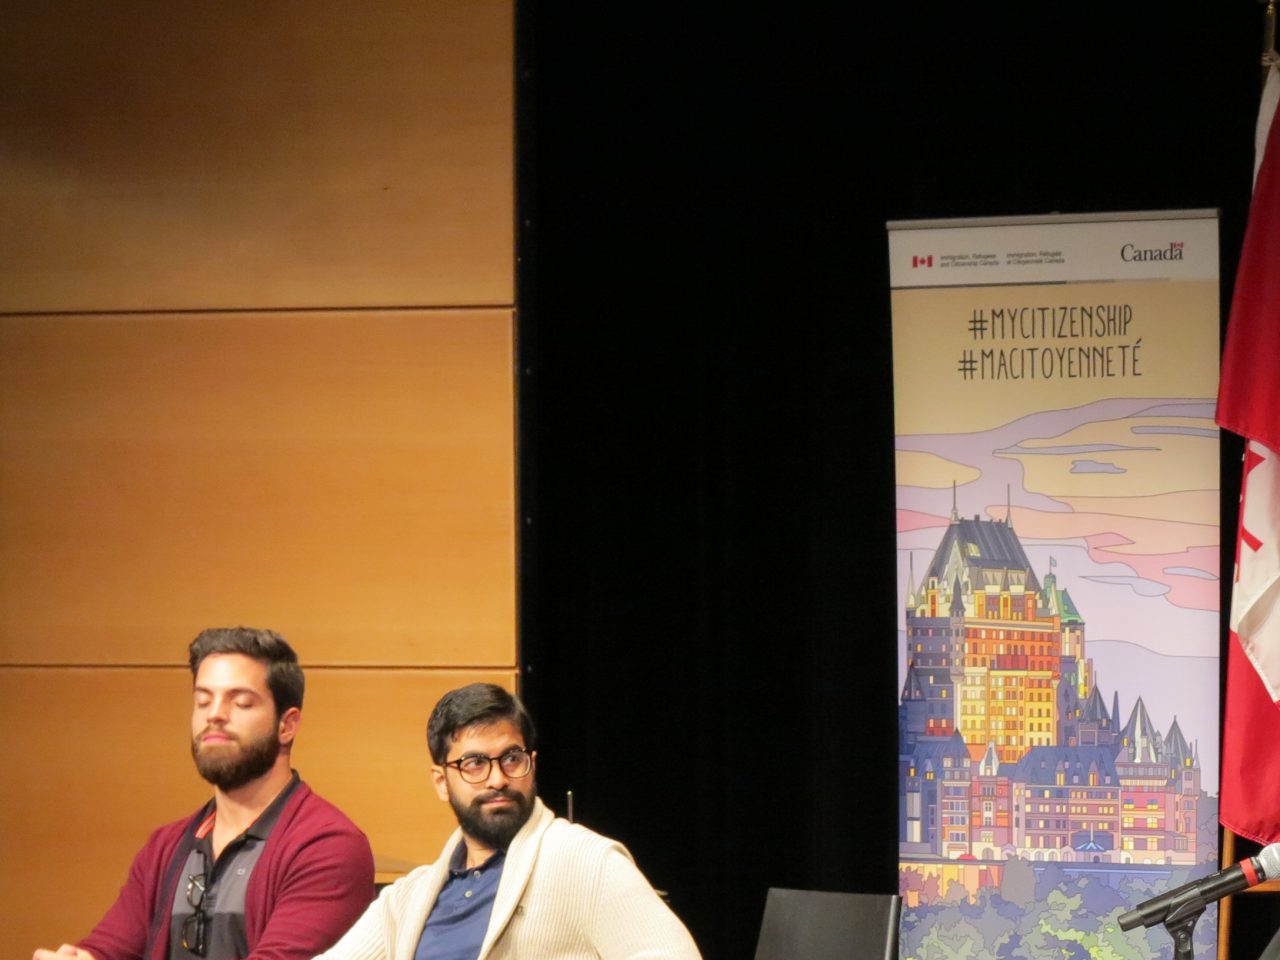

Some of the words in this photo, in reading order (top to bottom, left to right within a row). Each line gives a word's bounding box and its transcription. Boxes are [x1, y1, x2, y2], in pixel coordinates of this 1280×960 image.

[1120, 242, 1183, 262] Canada
[968, 304, 1133, 341] #MYCITIZENSHIP
[958, 338, 1143, 381] #MACITOYENNETÉ
